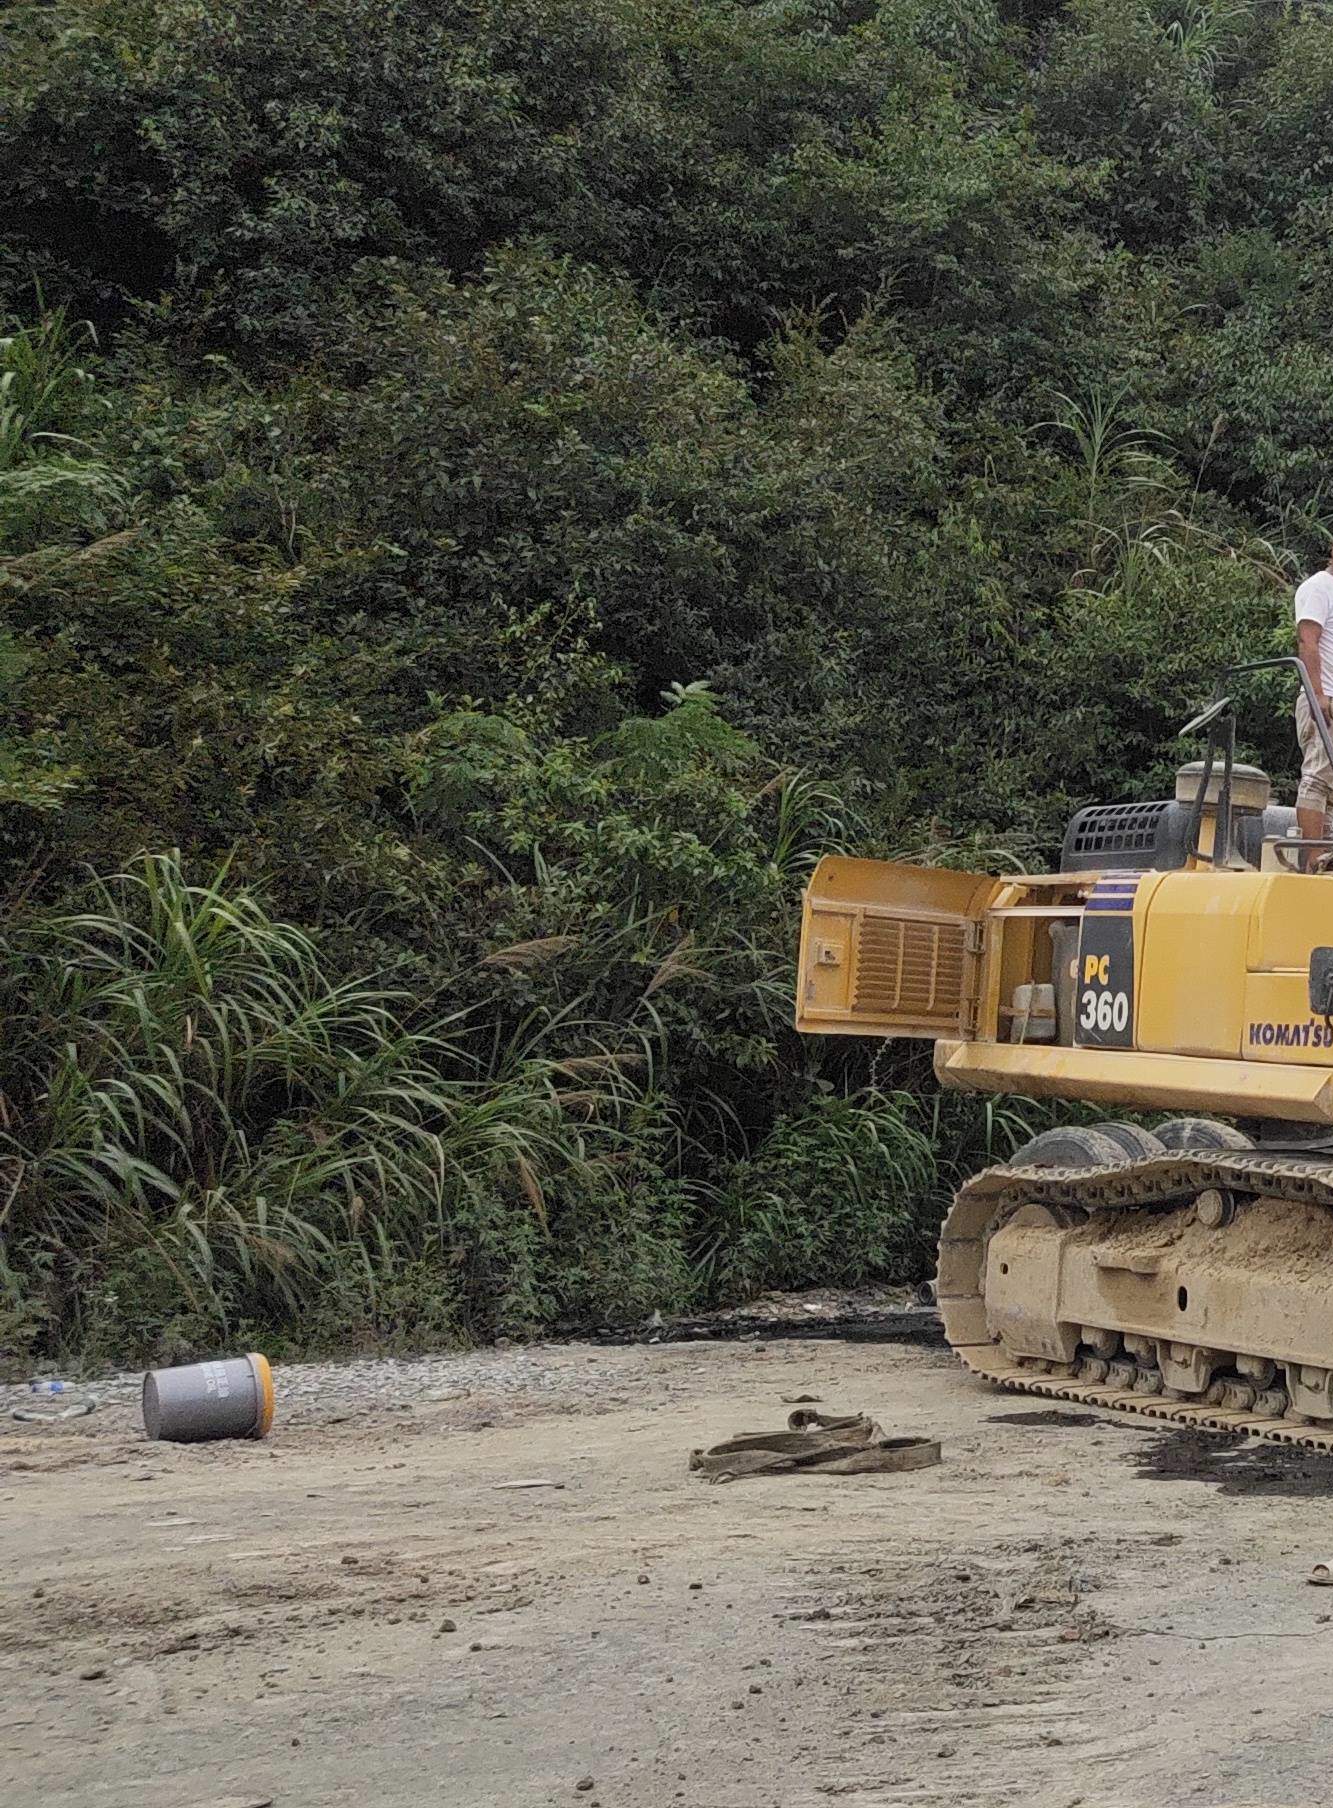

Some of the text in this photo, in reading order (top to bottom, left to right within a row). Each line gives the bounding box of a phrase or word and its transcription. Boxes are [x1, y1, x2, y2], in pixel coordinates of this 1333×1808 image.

[1084, 954, 1110, 986] PC
[1080, 990, 1129, 1032] 360
[1249, 1018, 1333, 1048] KOMATSU
